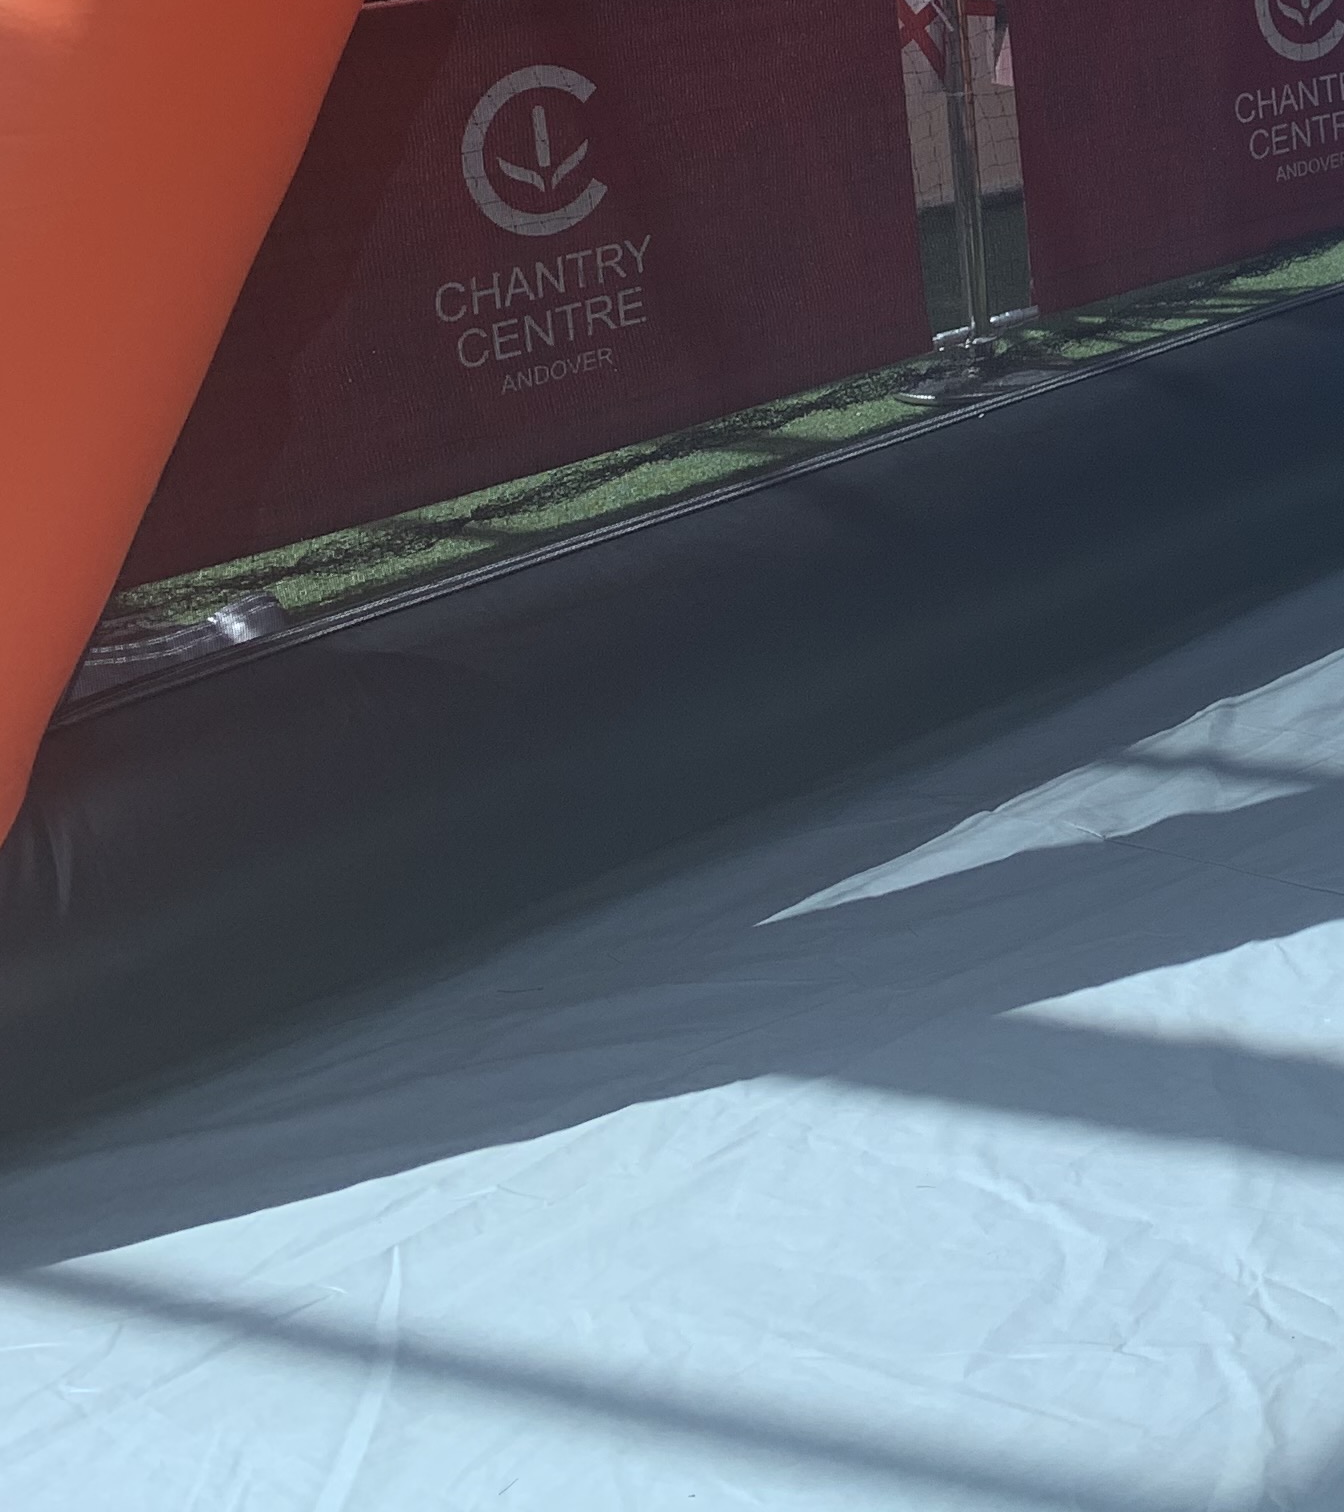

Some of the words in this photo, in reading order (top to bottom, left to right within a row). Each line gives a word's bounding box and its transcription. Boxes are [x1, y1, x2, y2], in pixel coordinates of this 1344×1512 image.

[435, 234, 652, 324] CHANTRY
[457, 286, 647, 368] CENTRE
[501, 348, 613, 393] ANDOVER
